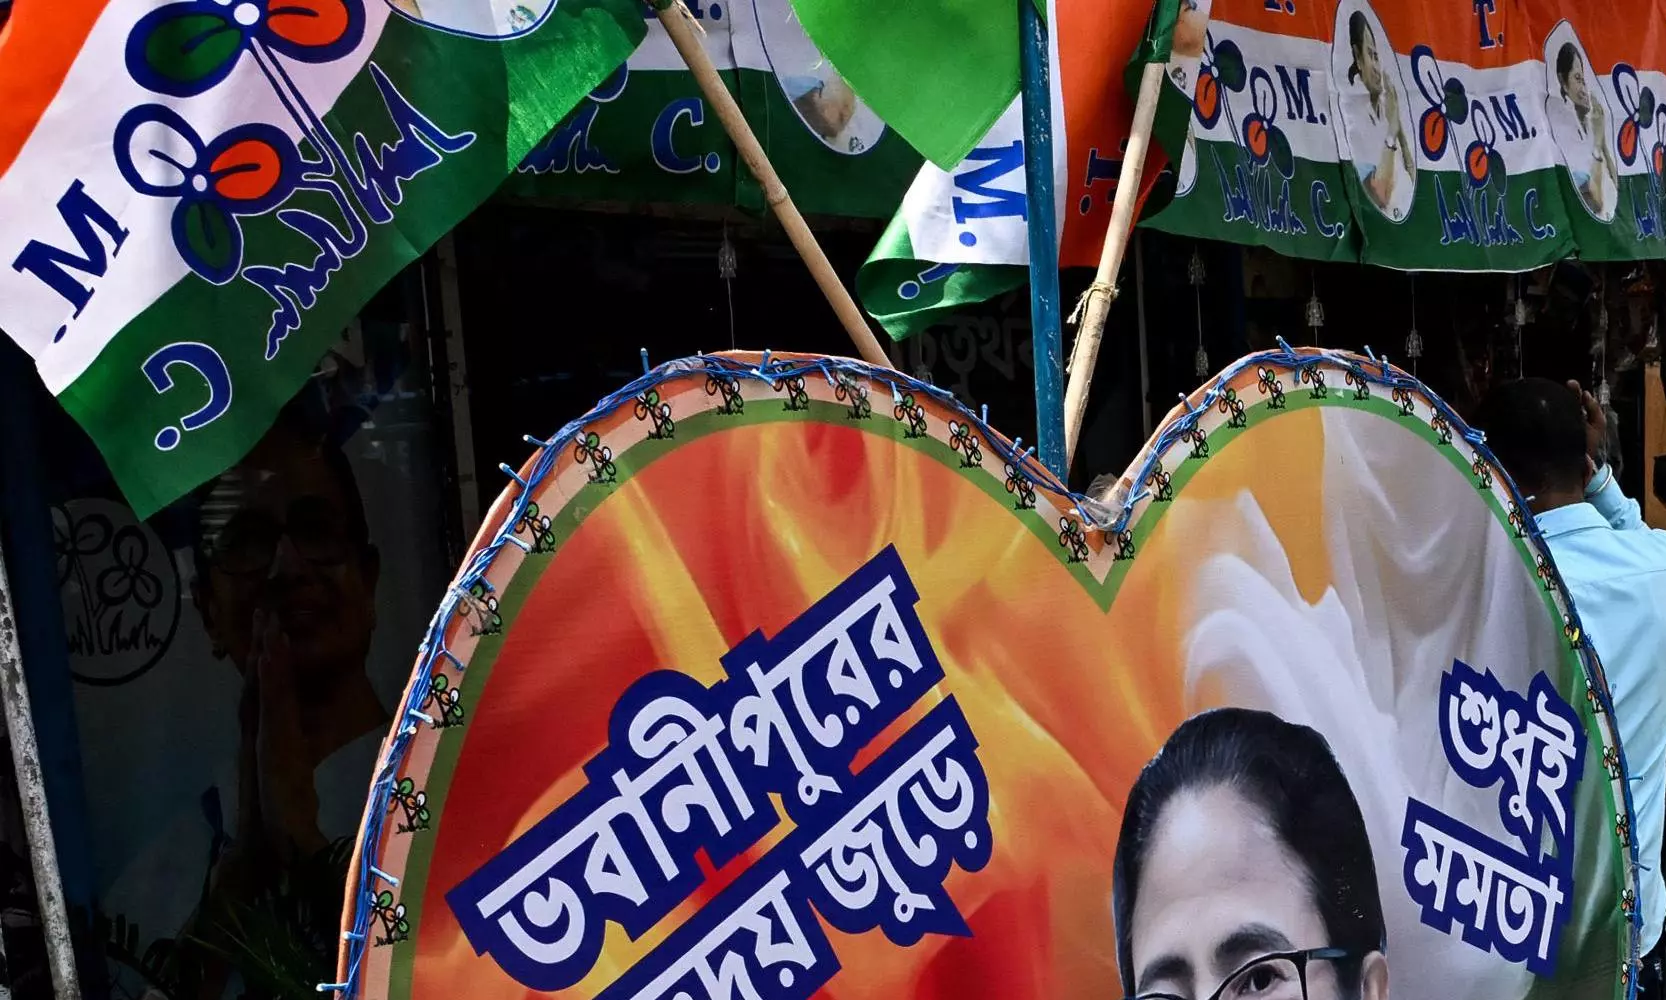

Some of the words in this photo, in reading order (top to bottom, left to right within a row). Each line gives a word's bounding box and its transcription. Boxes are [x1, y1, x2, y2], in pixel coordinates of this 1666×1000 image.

[1275, 65, 1327, 125] M.
[1489, 94, 1537, 142] M.
[651, 97, 720, 174] C.
[1311, 180, 1345, 239] C.
[1524, 188, 1557, 240] C.
[476, 574, 923, 965] ভবানীপুরের
[1450, 681, 1577, 836] শুধুই
[800, 725, 979, 923] জুড়ে
[1414, 819, 1564, 960] মমতা
